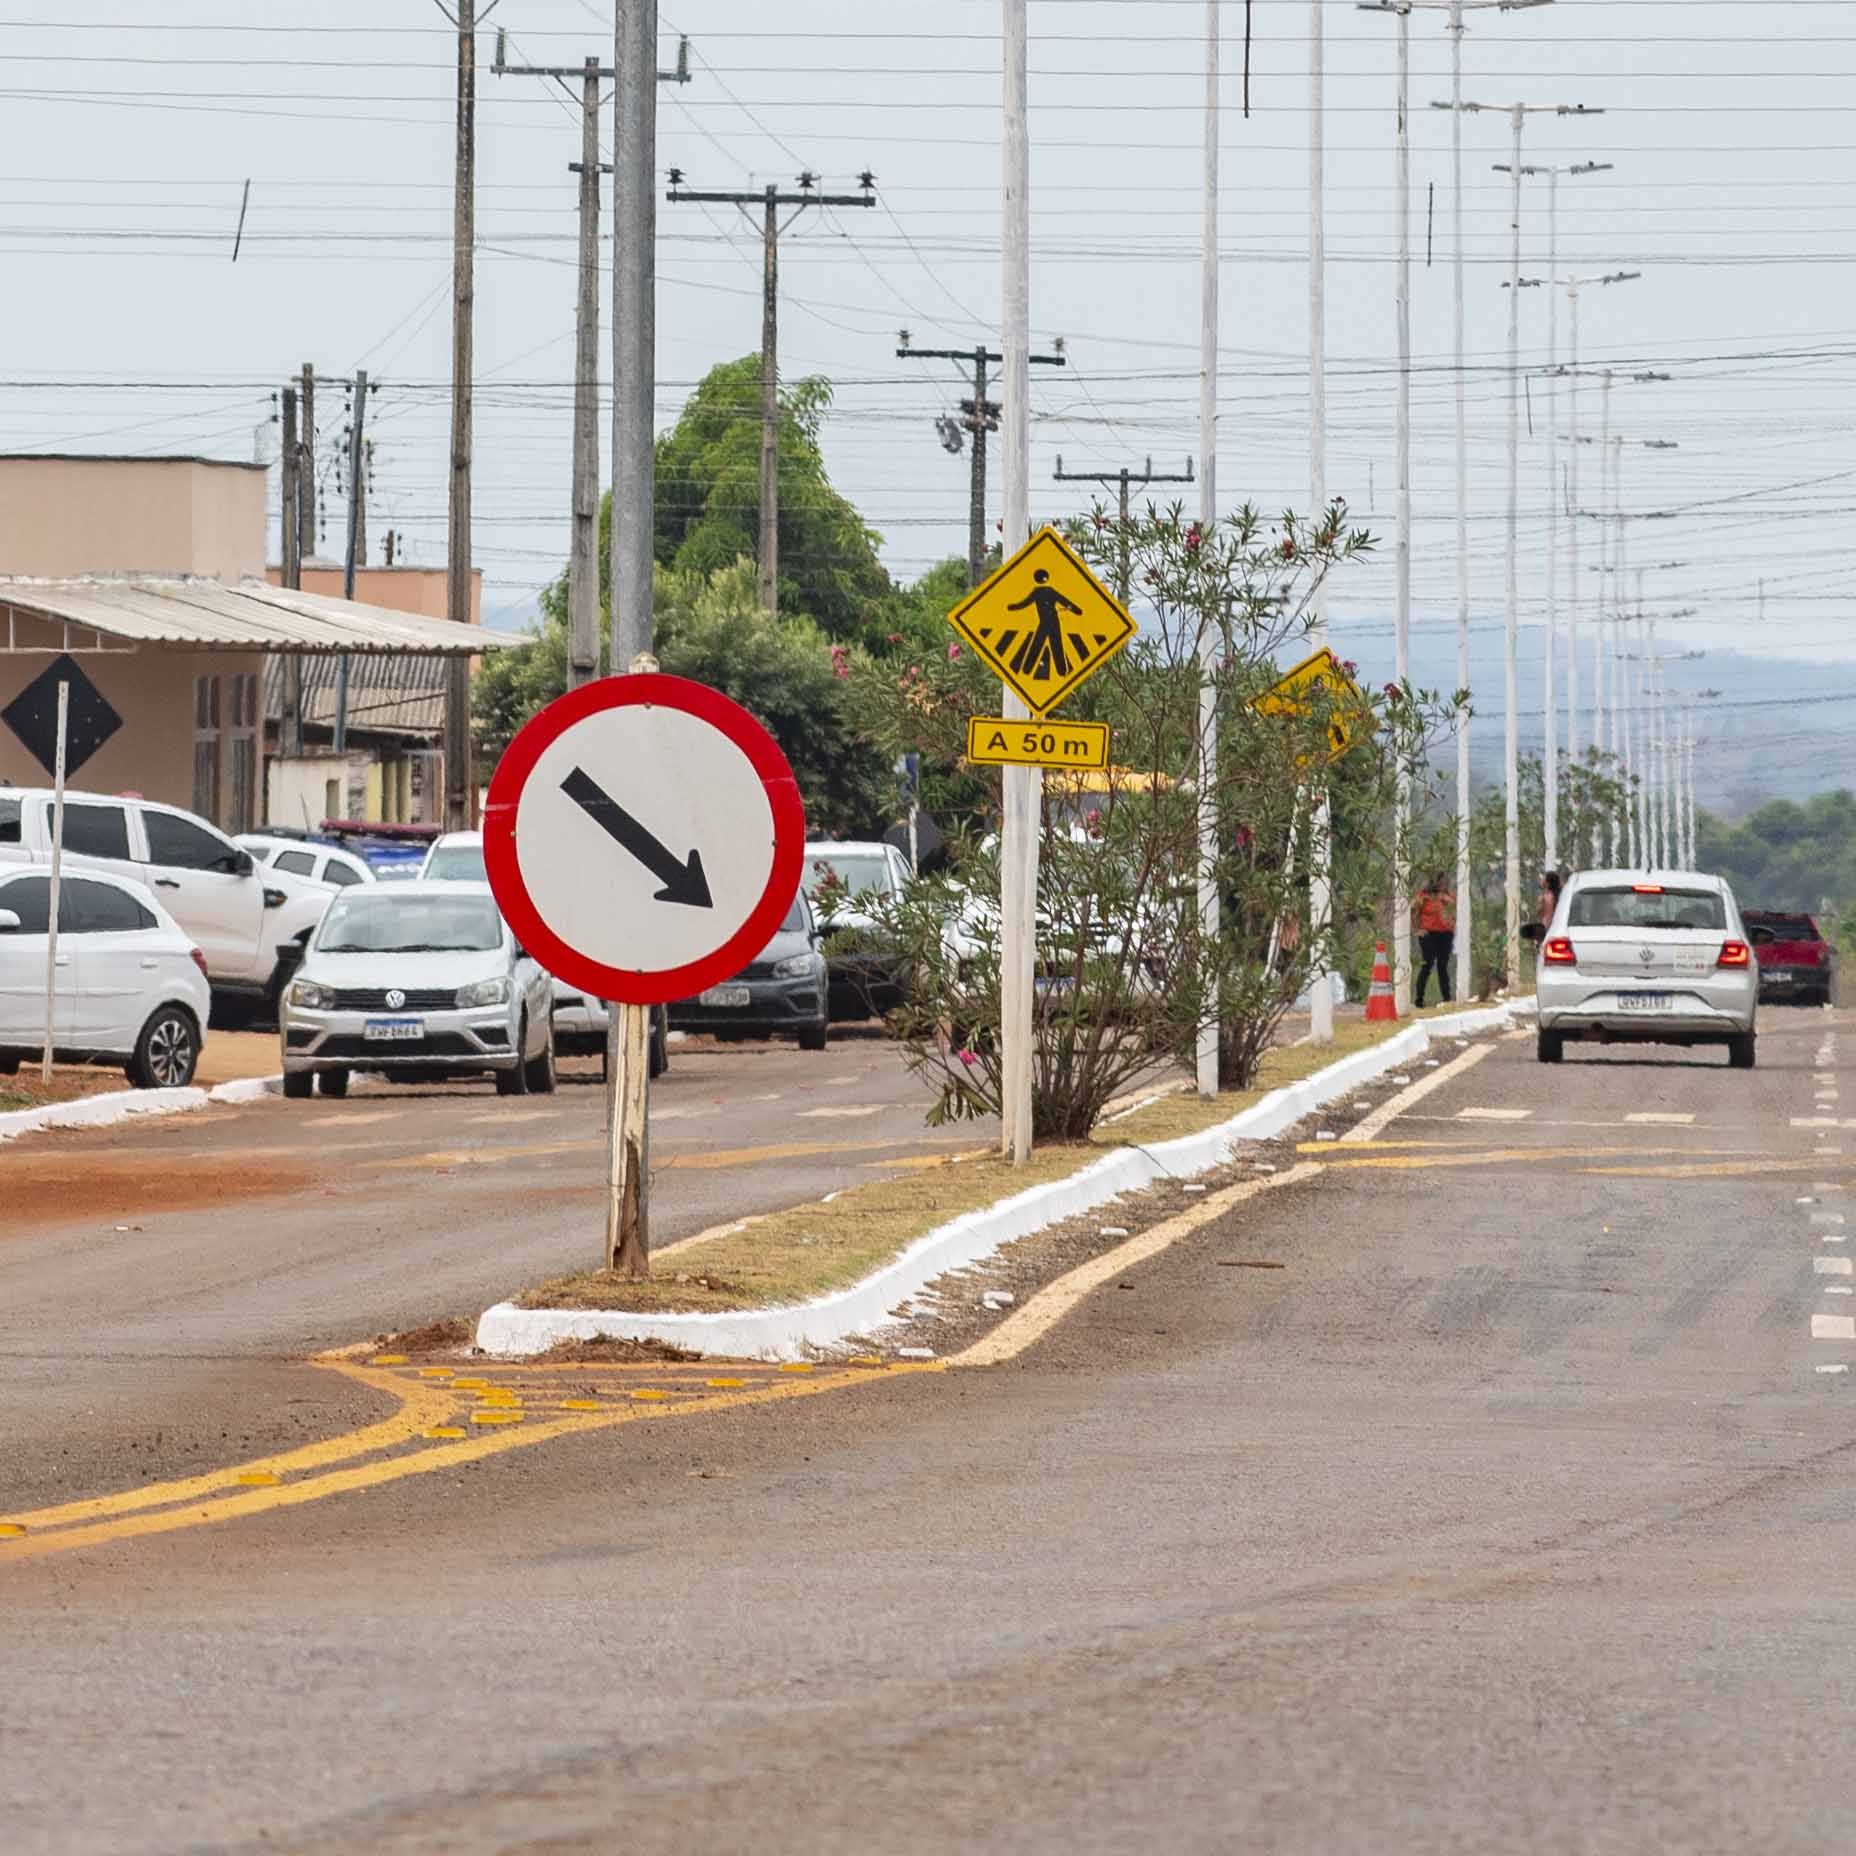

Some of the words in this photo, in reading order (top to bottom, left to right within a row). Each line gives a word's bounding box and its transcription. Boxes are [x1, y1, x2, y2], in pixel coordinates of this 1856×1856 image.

[987, 731, 1009, 752] A
[1022, 733, 1056, 755] 50
[1063, 739, 1089, 757] m
